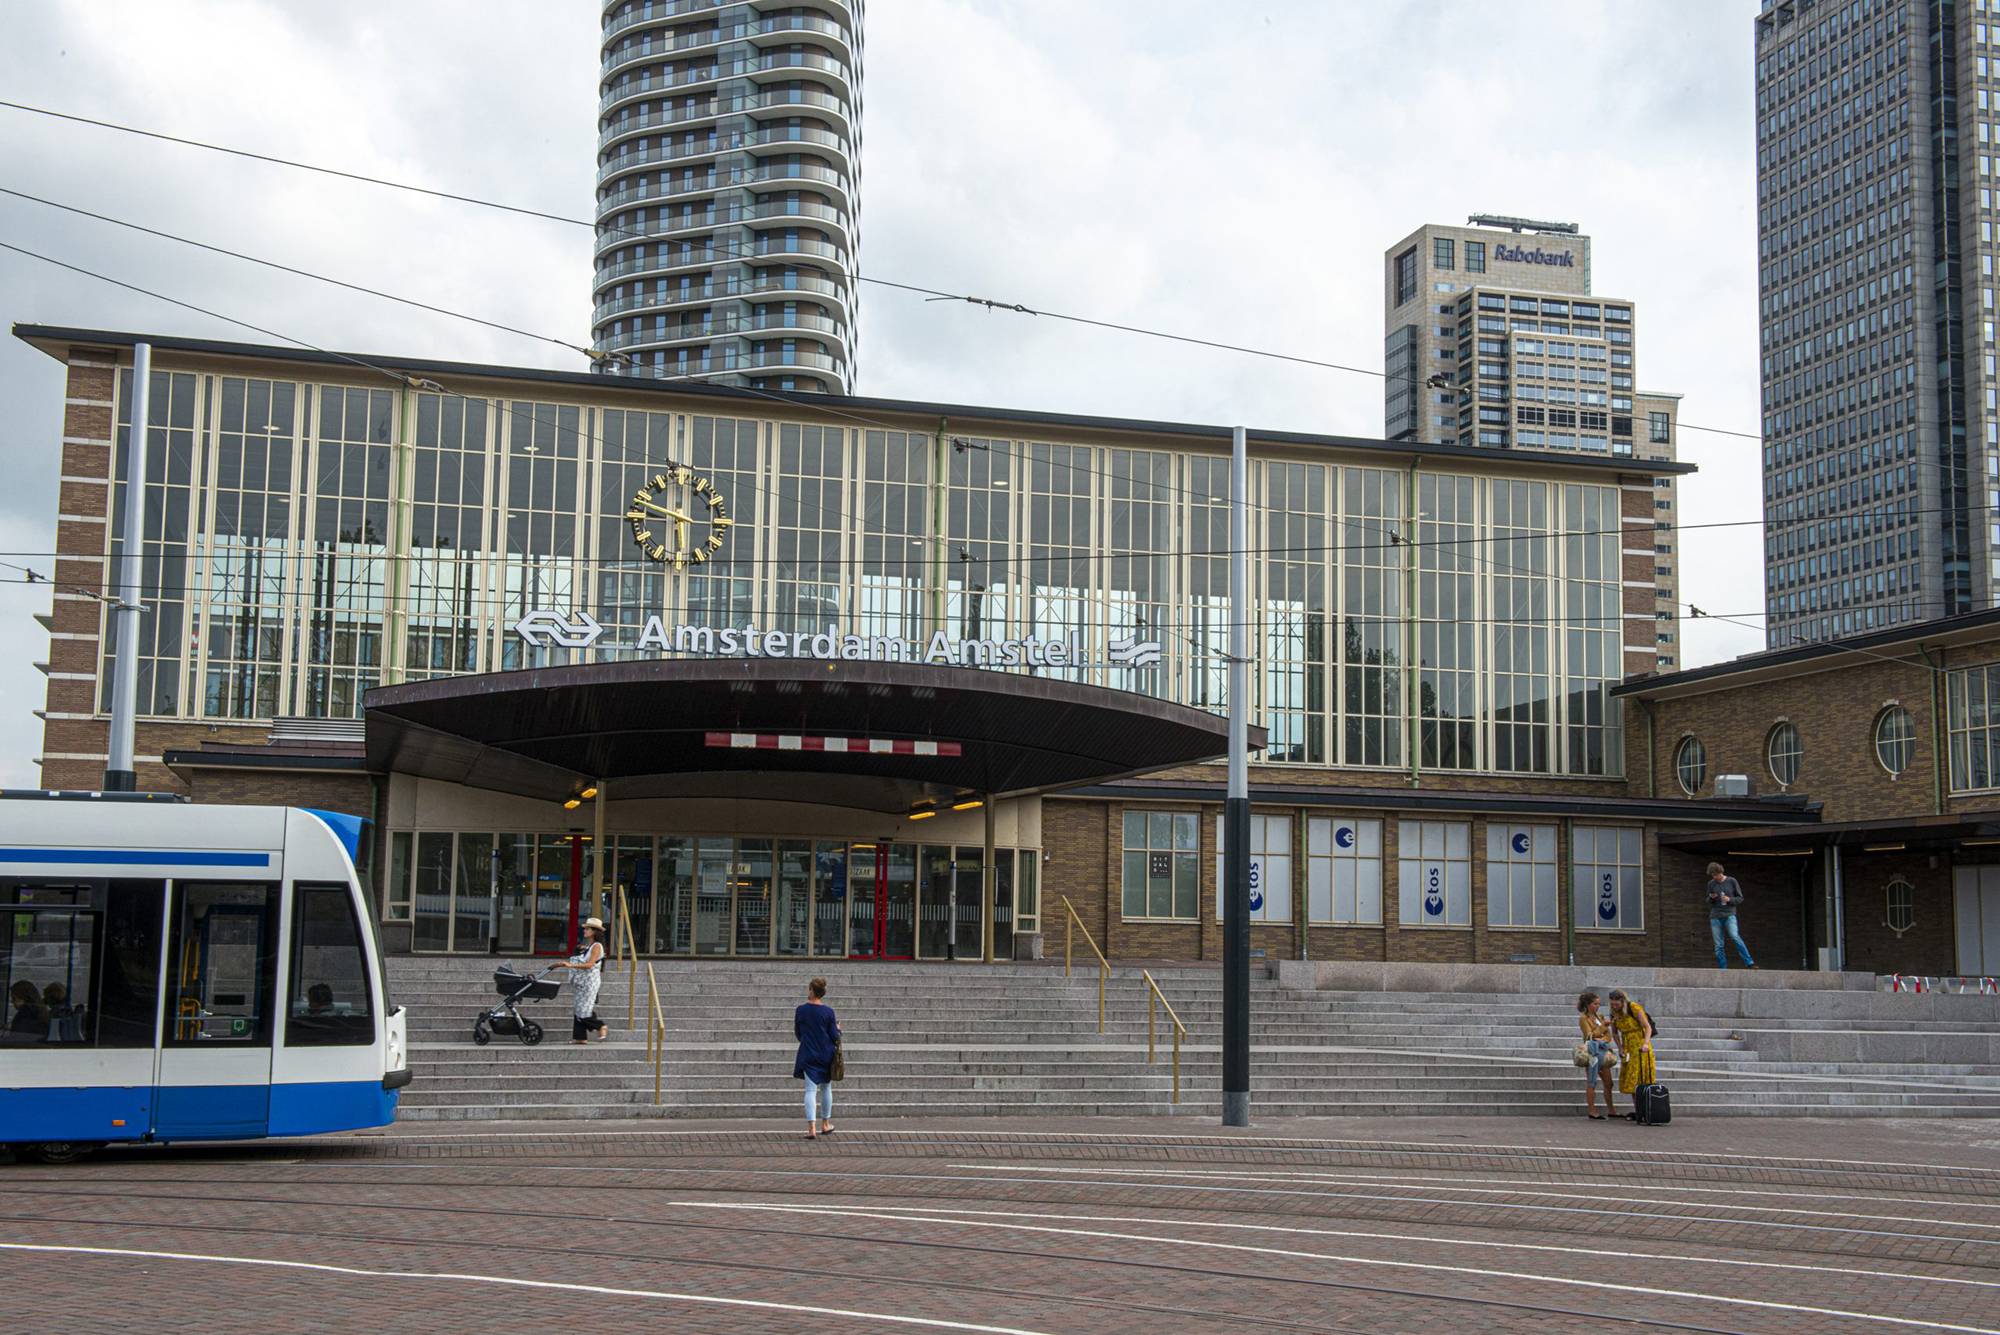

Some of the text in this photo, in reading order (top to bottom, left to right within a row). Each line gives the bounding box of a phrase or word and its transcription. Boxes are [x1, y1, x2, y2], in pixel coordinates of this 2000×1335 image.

[1494, 243, 1575, 267] Rabobank
[636, 614, 1083, 669] Amsterdam Amstel
[1427, 867, 1440, 909] etos
[1600, 873, 1613, 913] etos
